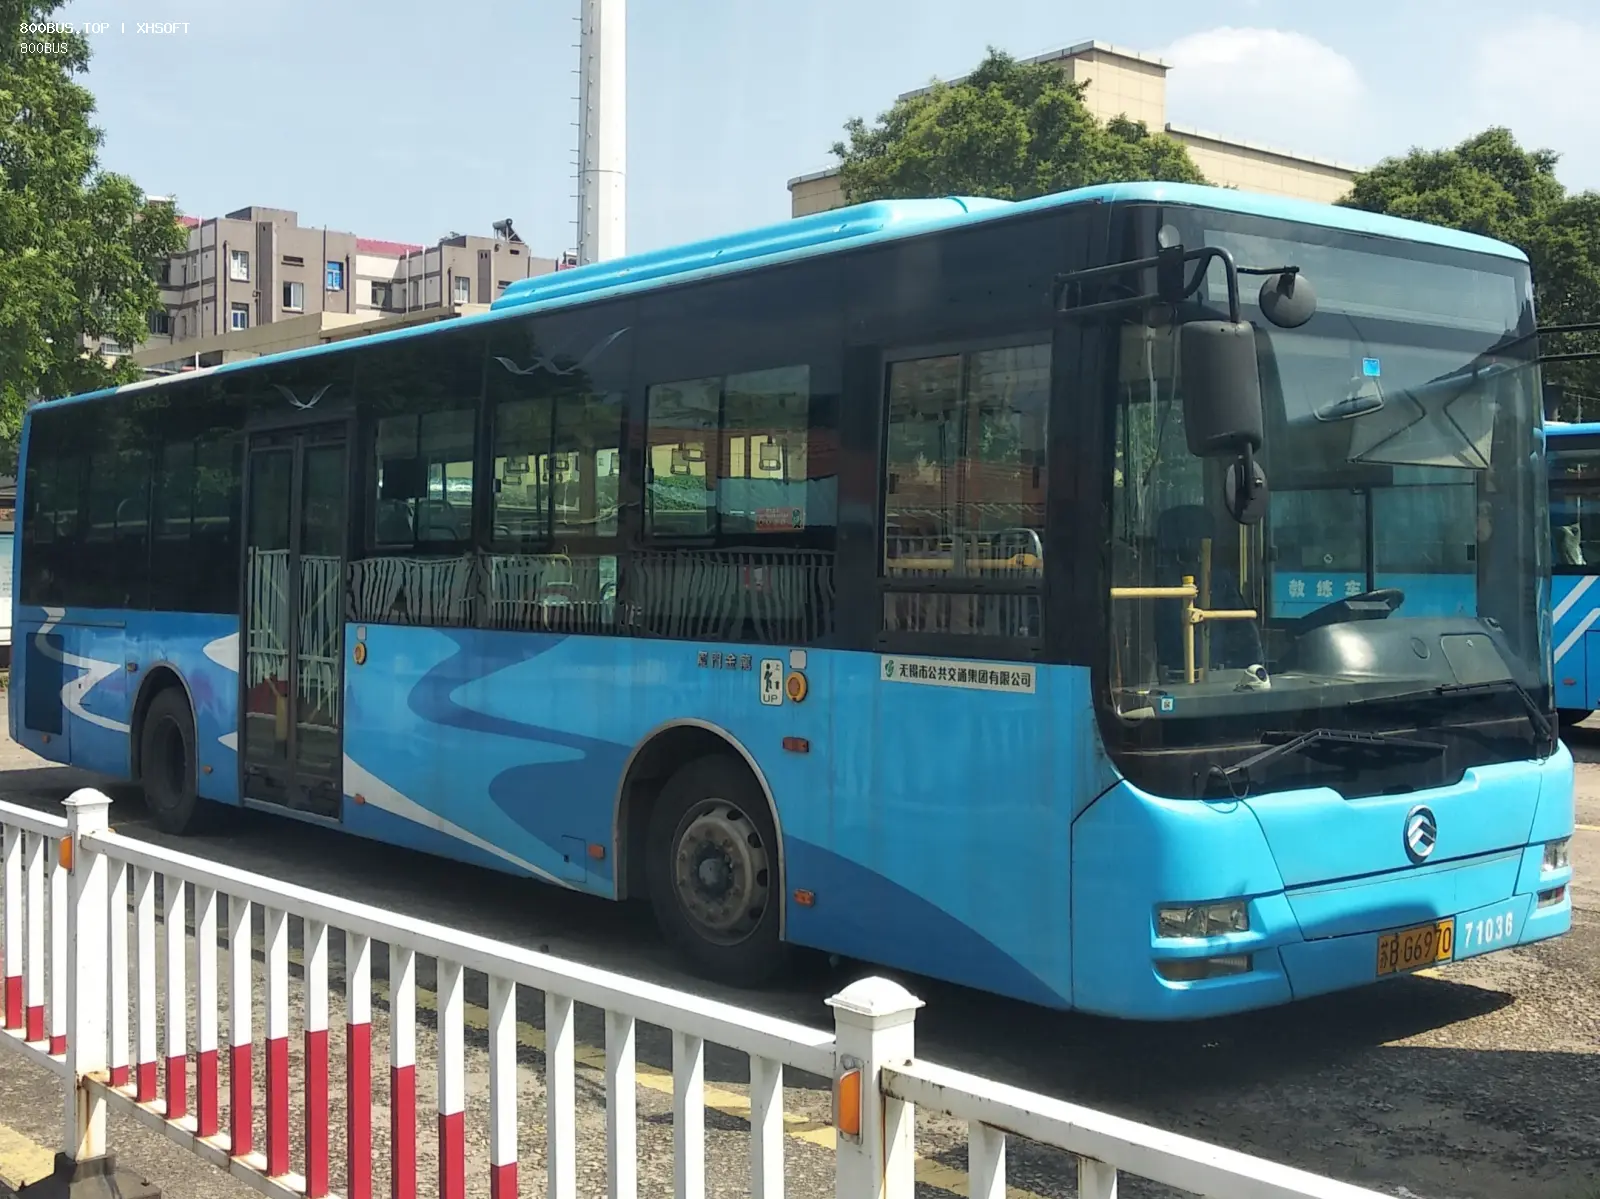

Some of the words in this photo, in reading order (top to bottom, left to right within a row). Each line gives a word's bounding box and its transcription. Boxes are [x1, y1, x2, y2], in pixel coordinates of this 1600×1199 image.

[899, 663, 1031, 688] 无锡市公共交通集团有限公司
[763, 693, 778, 703] UP
